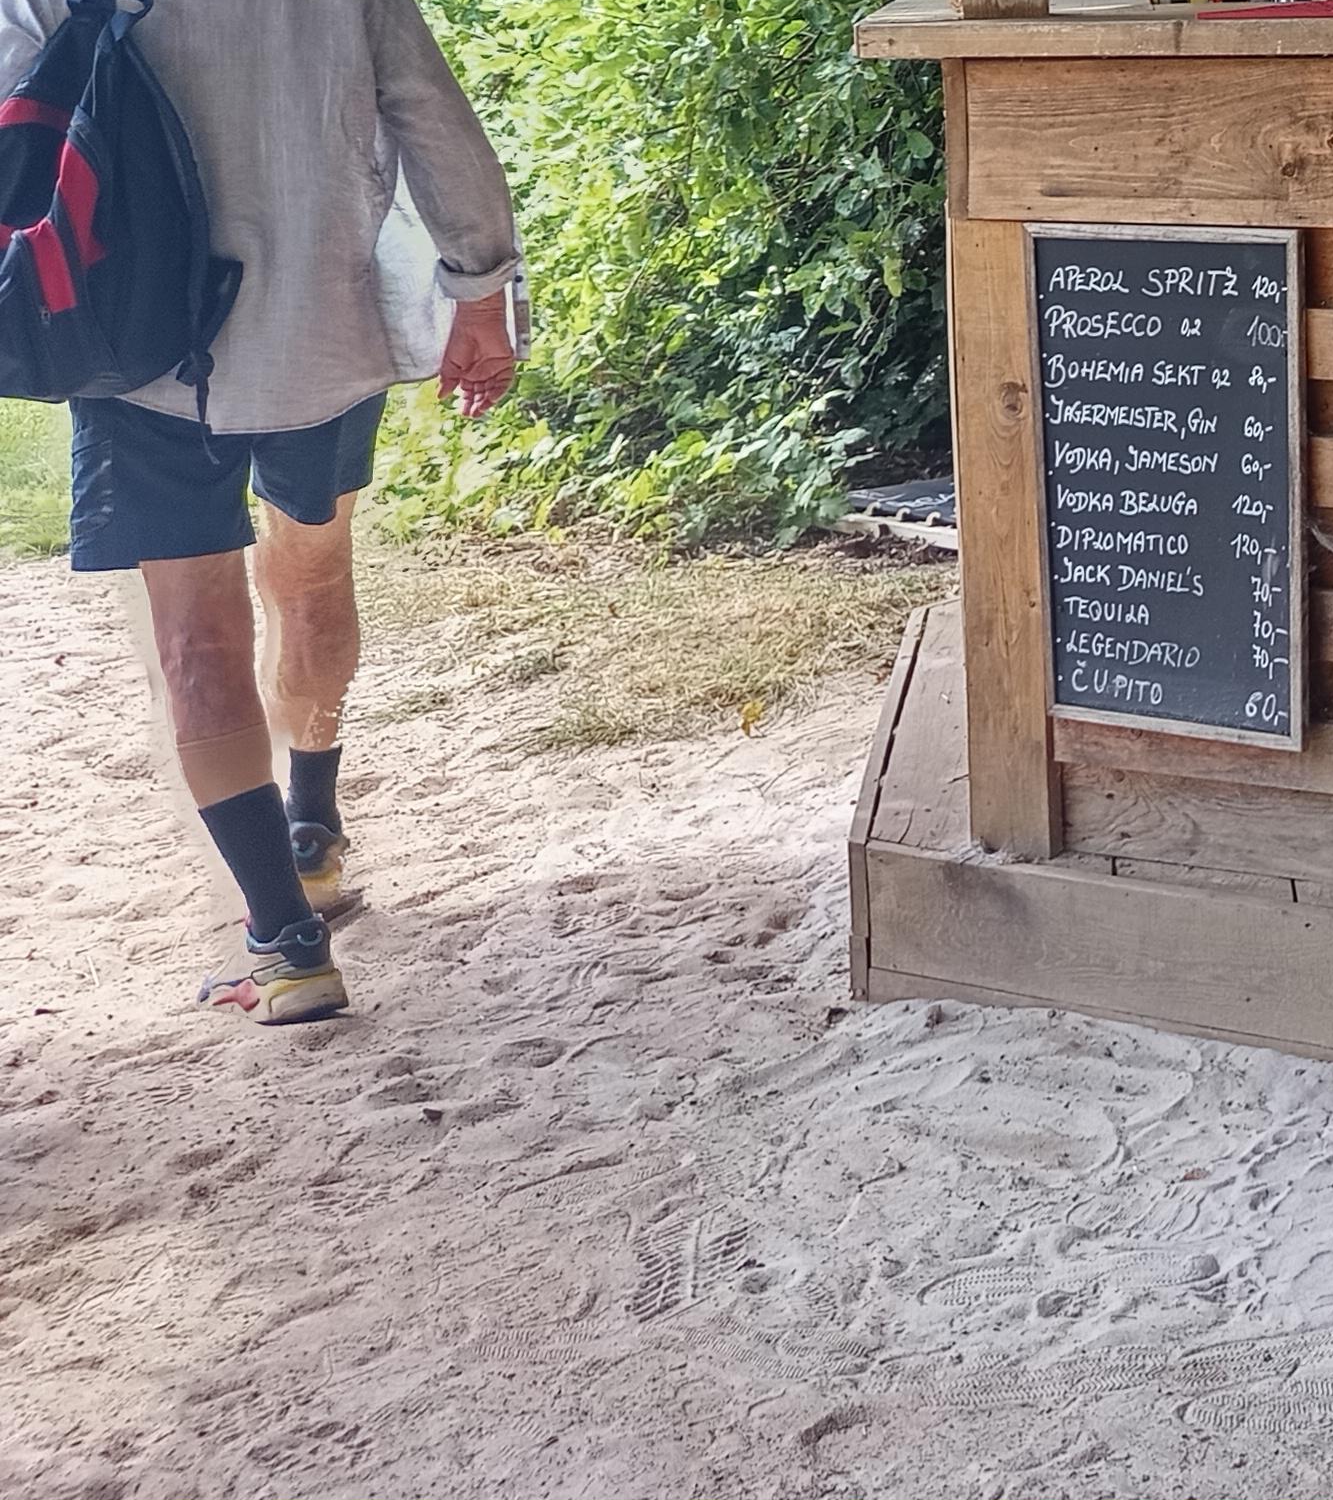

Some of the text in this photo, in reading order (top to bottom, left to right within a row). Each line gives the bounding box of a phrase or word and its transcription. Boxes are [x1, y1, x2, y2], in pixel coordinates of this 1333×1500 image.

[1049, 265, 1129, 293] APEROL
[1045, 304, 1162, 338] PROSECCO
[1181, 318, 1201, 337] 0,2
[1044, 353, 1144, 388] BOHEMIA
[1152, 361, 1206, 386] SEKT
[1211, 368, 1231, 389] 0,2
[1244, 416, 1273, 442] 60,-
[1125, 445, 1219, 475] JAMESON
[1057, 484, 1274, 524] VODKA BELUGA 120,-
[1056, 525, 1189, 555] DIPLOMATICO
[1060, 557, 1111, 586] JACK
[1117, 565, 1204, 597] DANIEL'S
[1064, 596, 1149, 625] TEQUILA
[1066, 629, 1200, 668] LEGENDARIO
[1071, 660, 1163, 705] ČUPITO
